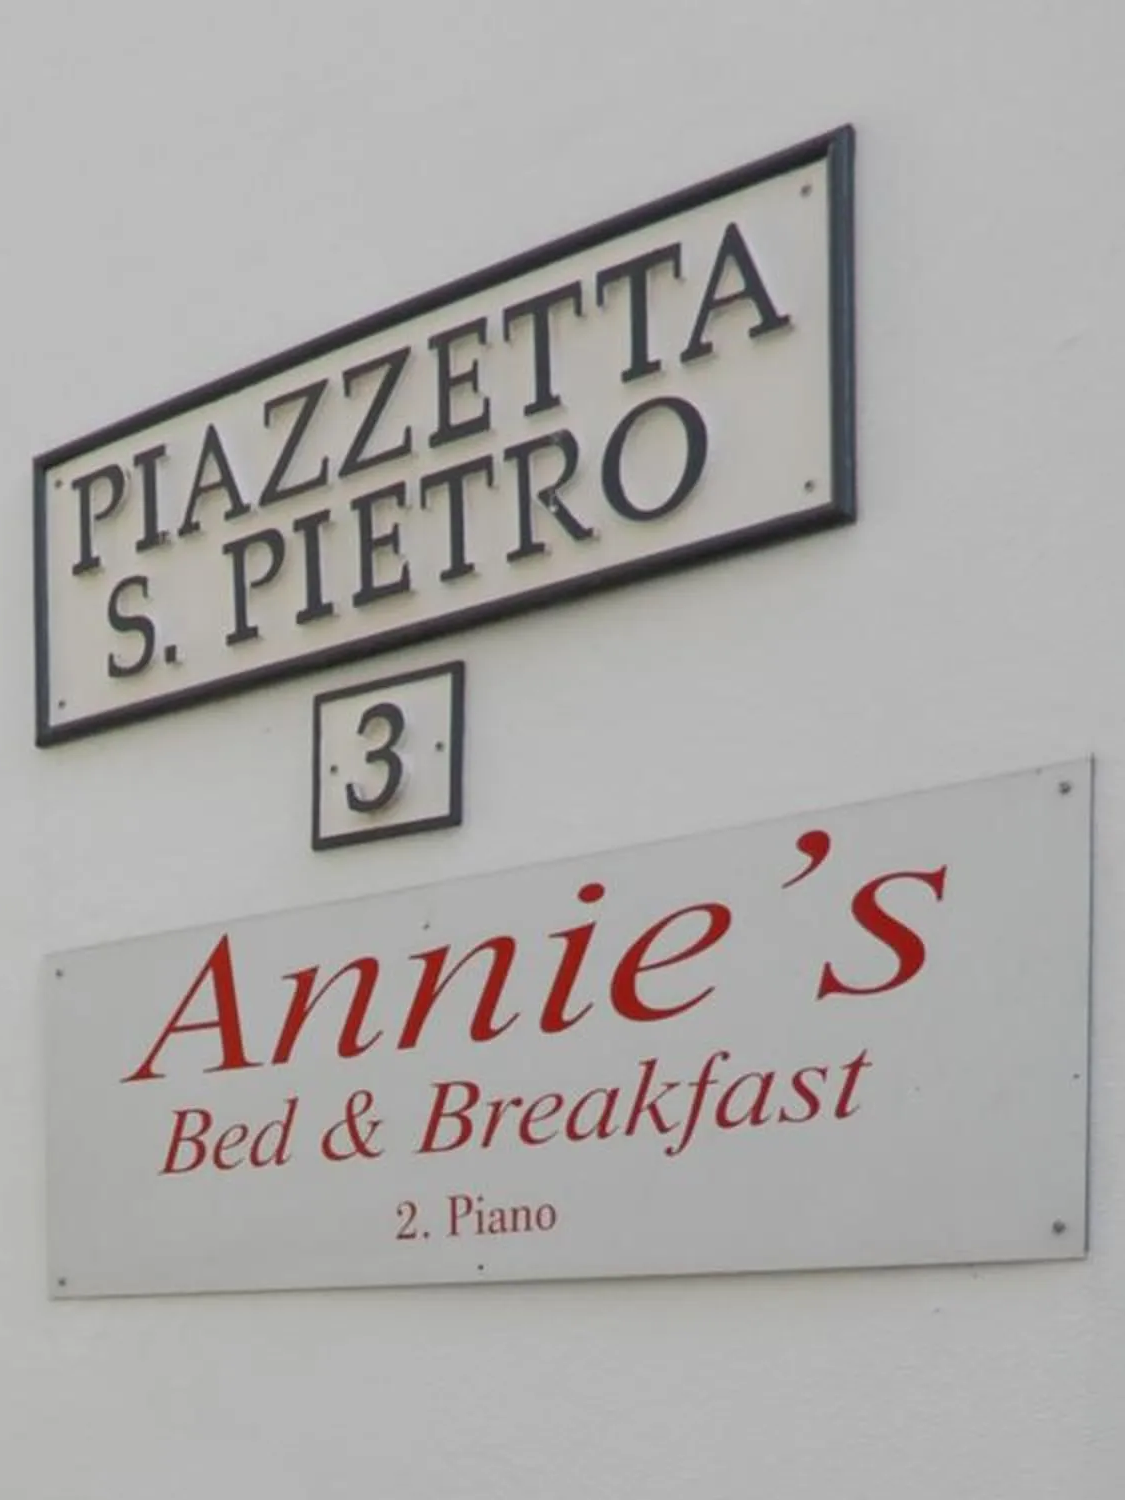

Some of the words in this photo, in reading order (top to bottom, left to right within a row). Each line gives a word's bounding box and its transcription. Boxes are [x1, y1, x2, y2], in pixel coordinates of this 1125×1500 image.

[72, 221, 791, 576] PIAZZETTA
[106, 575, 179, 679] S.
[223, 395, 709, 646] PIETRO
[345, 702, 406, 813] 3
[121, 829, 949, 1083] Annie's
[158, 1096, 297, 1175] Bed
[320, 1089, 385, 1161] &
[418, 1047, 872, 1156] Breakfast
[394, 1200, 431, 1240] 2.
[446, 1194, 557, 1238] Piano
